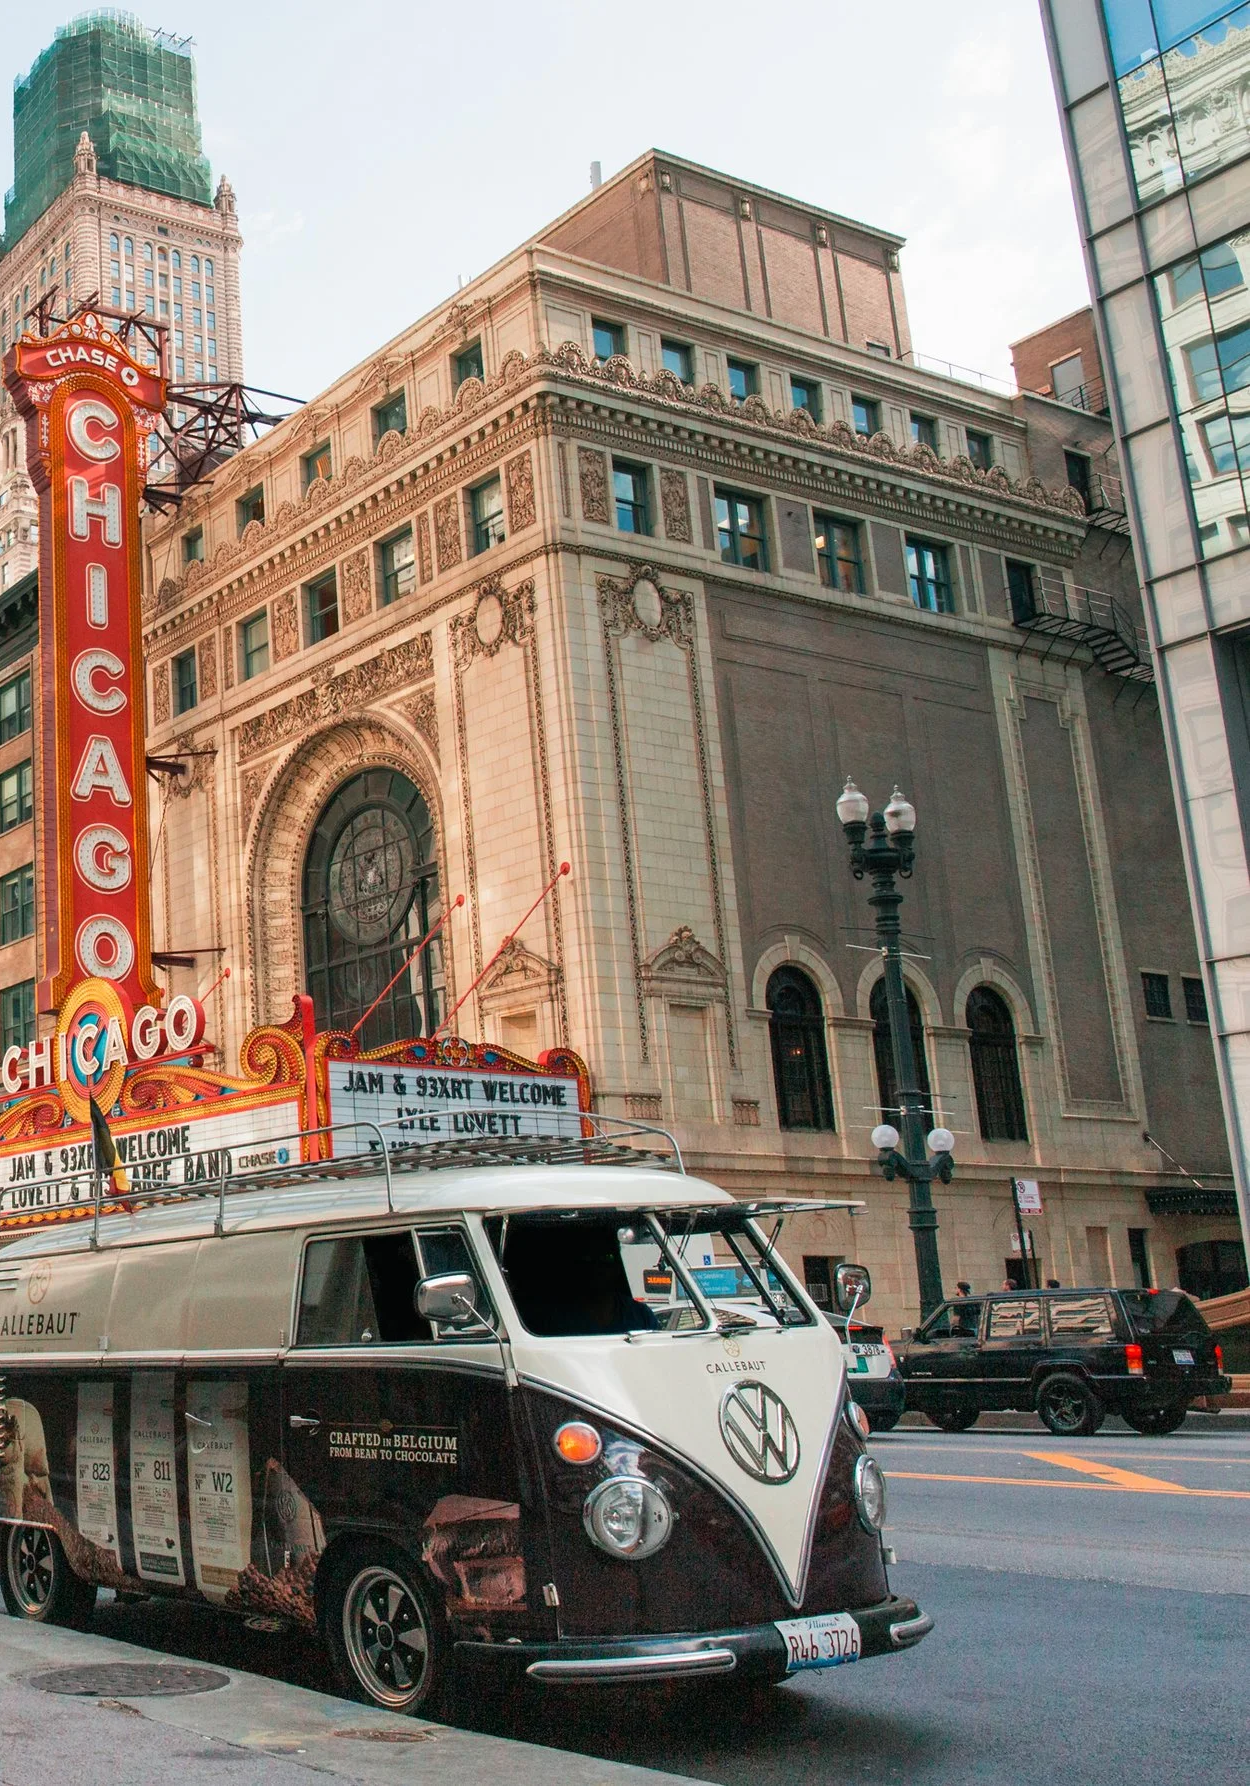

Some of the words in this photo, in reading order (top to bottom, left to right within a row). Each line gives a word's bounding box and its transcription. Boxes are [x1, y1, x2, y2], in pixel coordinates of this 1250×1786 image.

[45, 345, 119, 373] CHASE
[67, 399, 136, 983] CHICAGO
[1, 994, 199, 1094] CHICAGO
[342, 1069, 384, 1095] JAM
[392, 1073, 407, 1096] &
[416, 1075, 474, 1100] 93XRT
[481, 1079, 568, 1107] WELCOME
[397, 1106, 441, 1132] LYLE
[452, 1110, 522, 1136] LOVETT
[8, 1153, 36, 1183] JAM
[44, 1150, 53, 1176] &
[114, 1124, 191, 1164] WELCOME
[184, 1150, 232, 1183] BAND
[238, 1150, 277, 1169] CHASE
[705, 1360, 767, 1374] CALLEBAUT
[329, 1431, 381, 1447] CRAFTED
[393, 1434, 458, 1450] BELGIUM
[329, 1446, 353, 1458] FROM
[354, 1447, 378, 1459] BEAN
[379, 1449, 392, 1460] TO
[394, 1450, 458, 1464] CHOCOLATE
[92, 1462, 111, 1482] 823
[153, 1459, 172, 1481] 811
[211, 1471, 234, 1493] W2
[788, 1632, 819, 1663] R46
[824, 1627, 858, 1658] 3726
